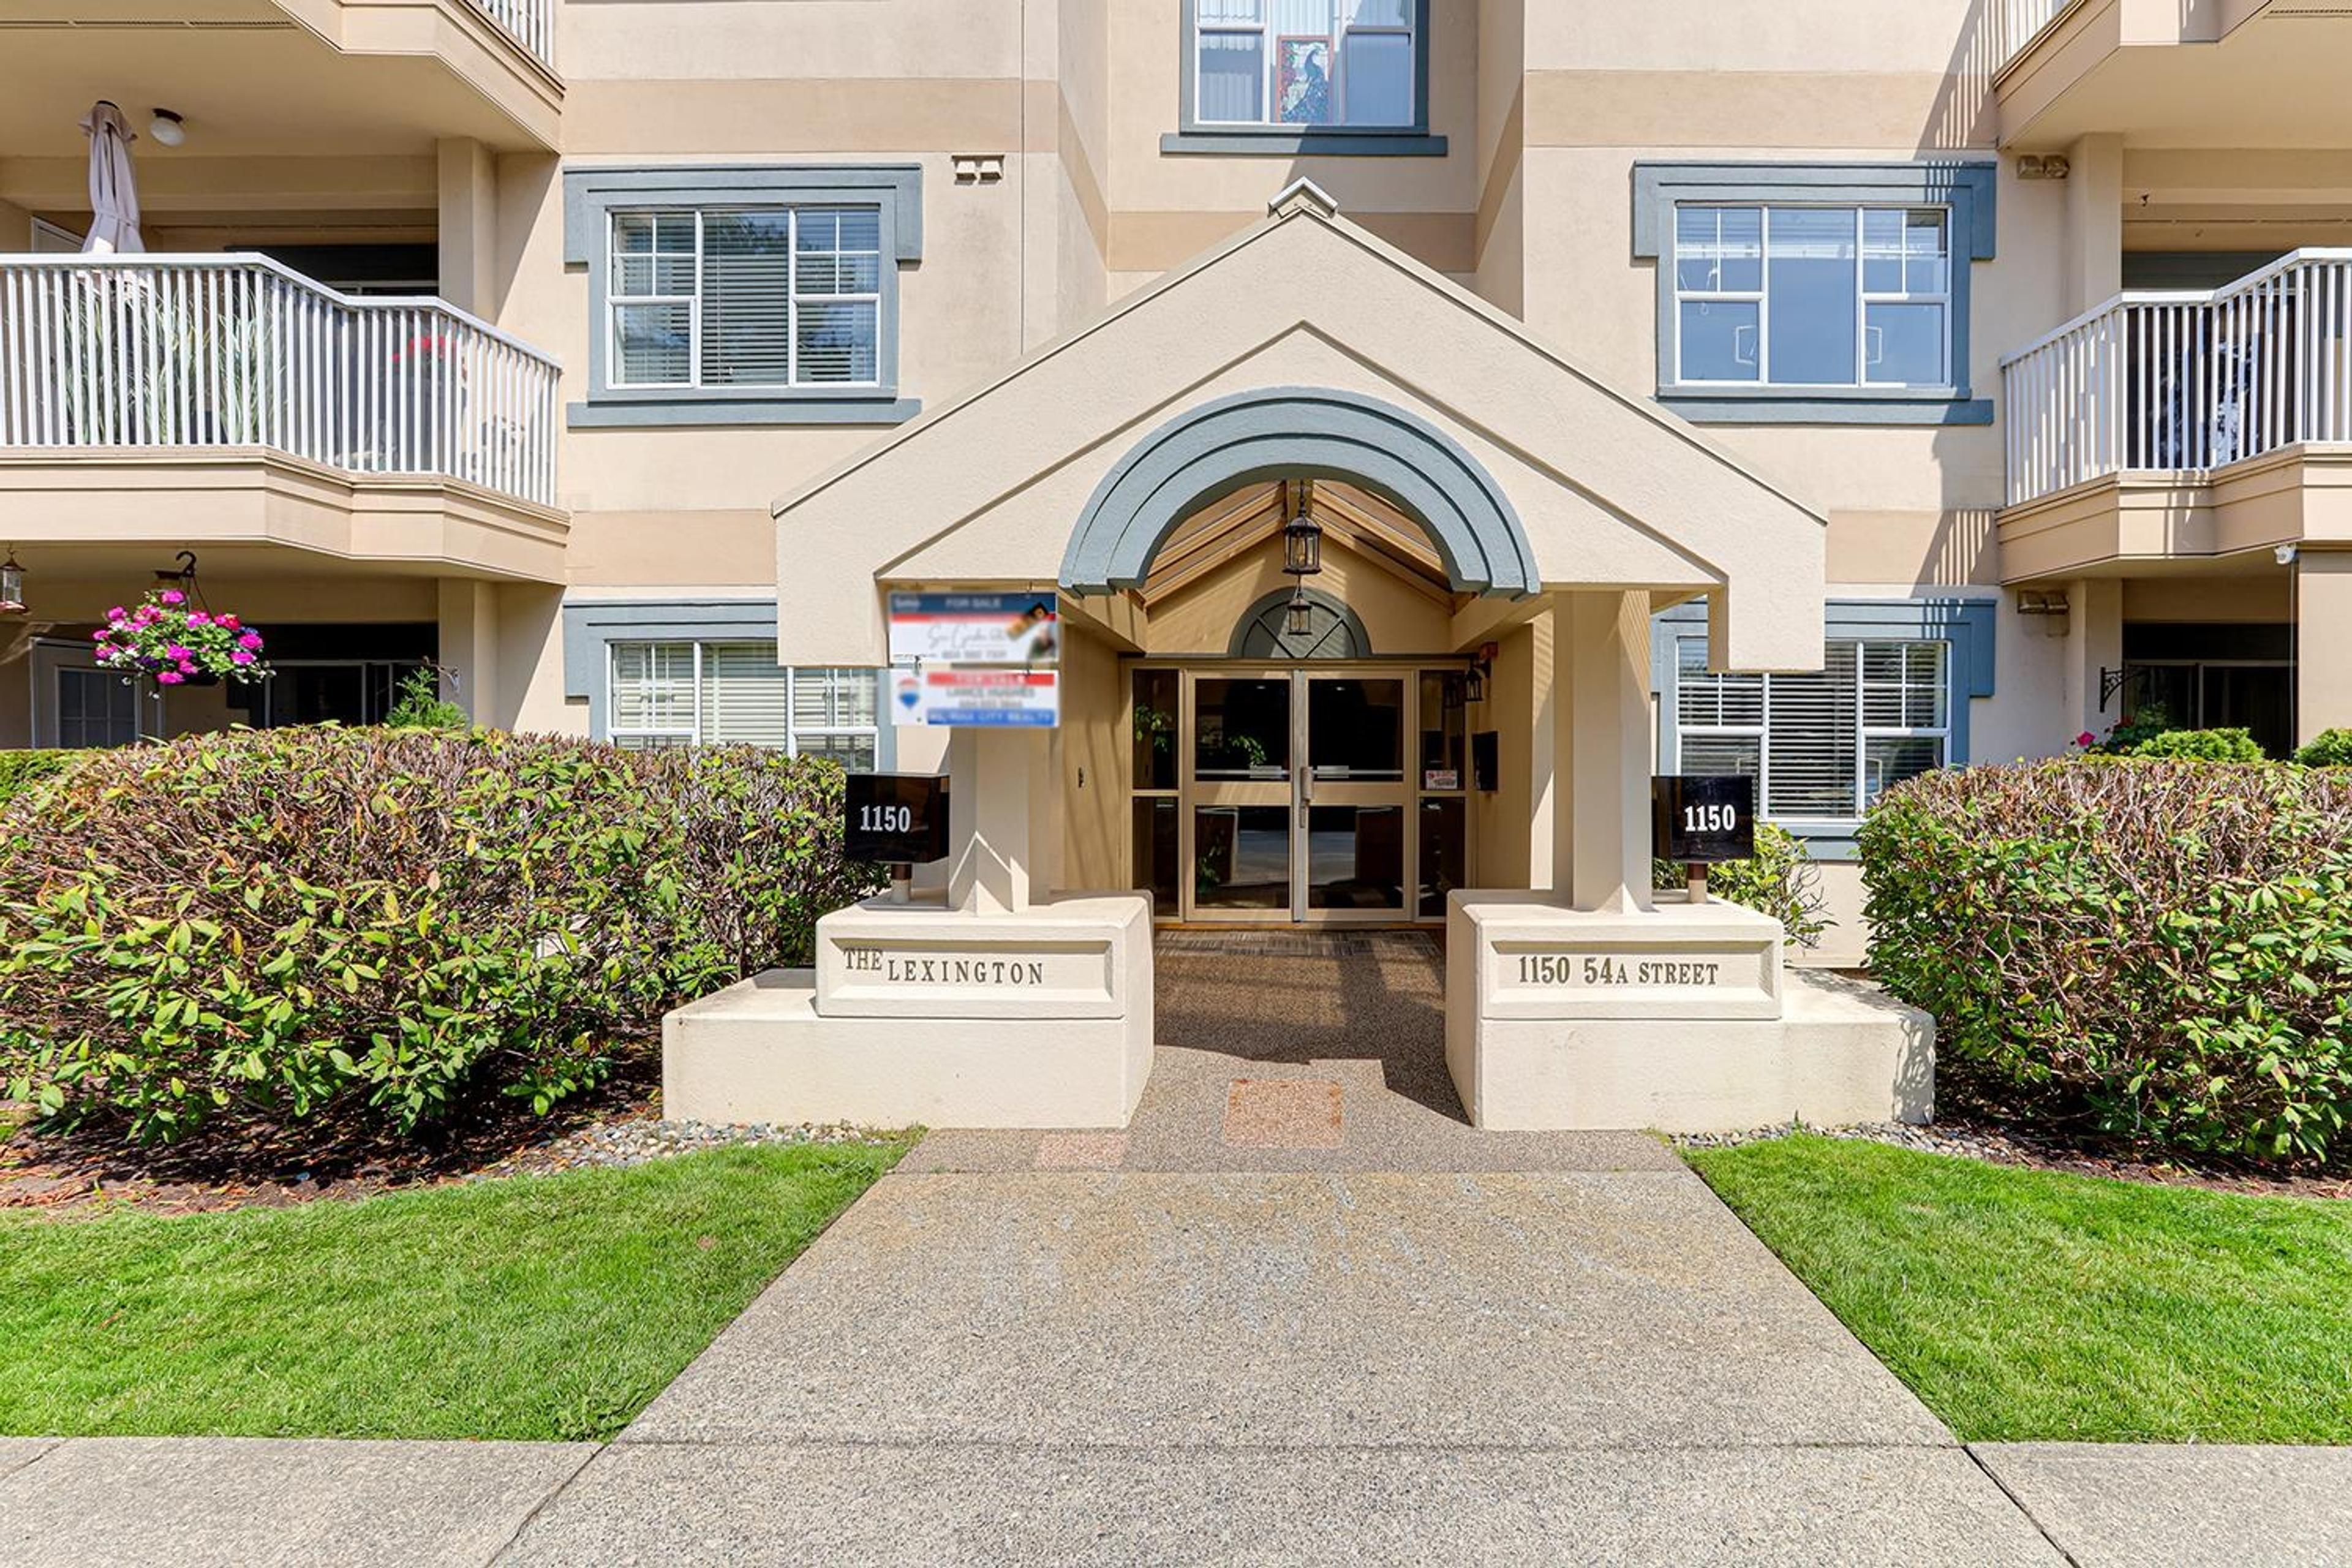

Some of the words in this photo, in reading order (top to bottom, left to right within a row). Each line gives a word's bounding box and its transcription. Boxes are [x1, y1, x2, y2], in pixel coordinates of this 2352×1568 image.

[860, 805, 910, 833] 1150
[1684, 804, 1735, 832] 1150
[843, 948, 883, 970] THE
[888, 959, 1043, 984] LEXINGTON
[1519, 957, 1570, 984] 1150
[1583, 957, 1629, 984] 54A
[1638, 963, 1719, 985] STREET
